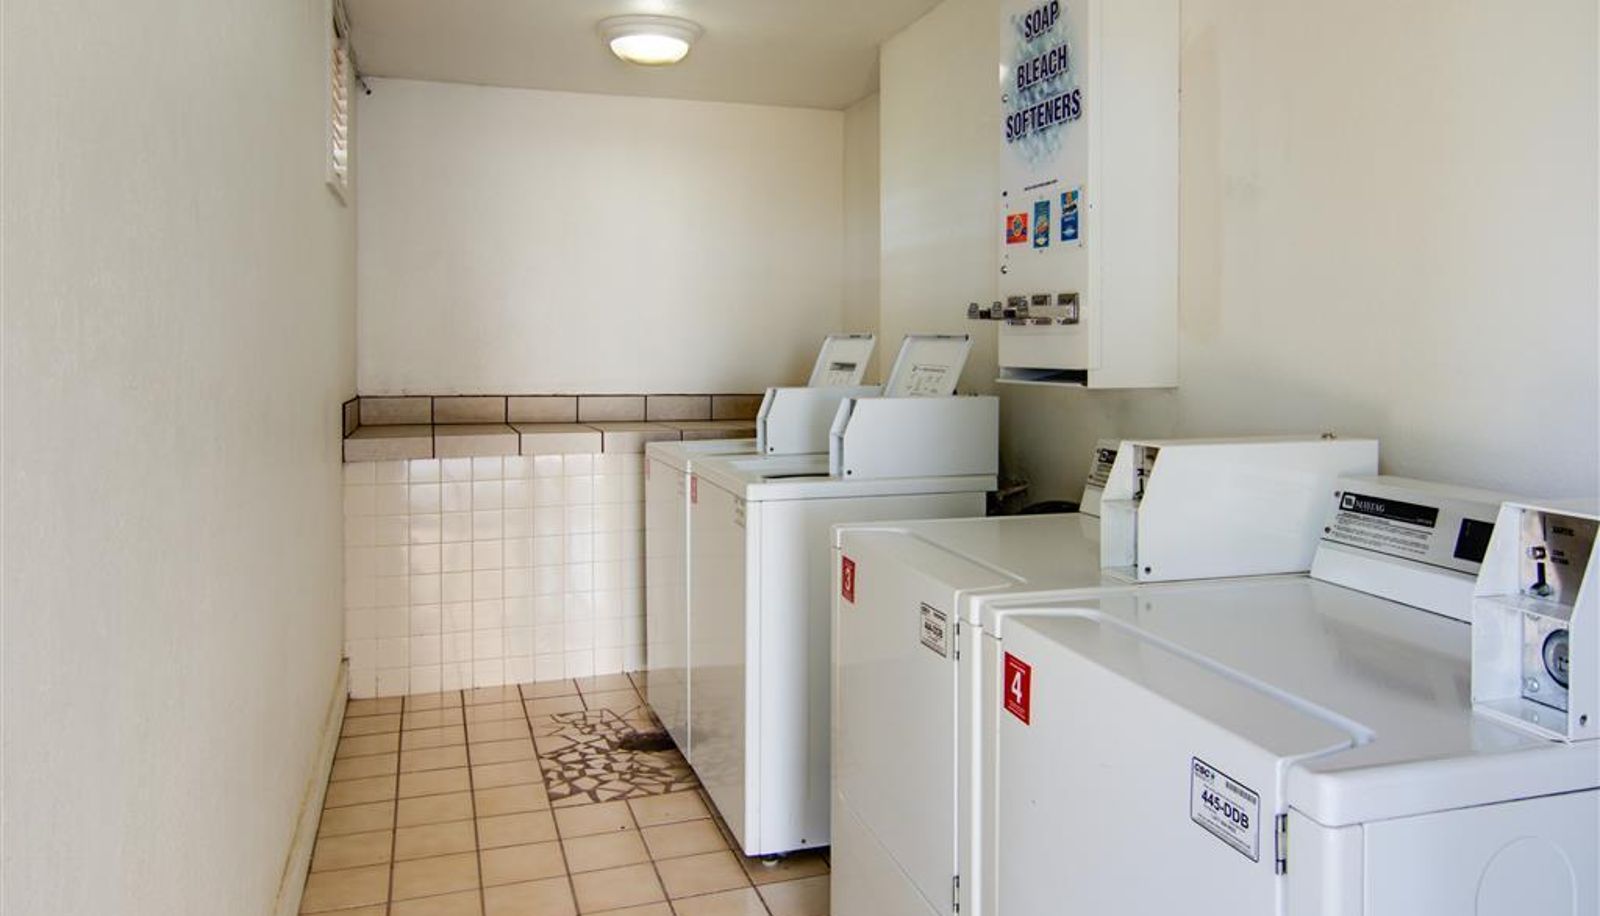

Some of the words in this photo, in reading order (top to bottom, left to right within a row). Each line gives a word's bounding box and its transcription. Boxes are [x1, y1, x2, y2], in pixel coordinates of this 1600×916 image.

[1024, 0, 1060, 40] SOAP
[1017, 44, 1068, 89] BLEACH
[1006, 88, 1082, 140] SOFTENERS
[844, 568, 852, 592] 3
[1011, 671, 1023, 704] 4
[1194, 762, 1211, 778] CSC
[1201, 789, 1250, 829] 445-DDB
